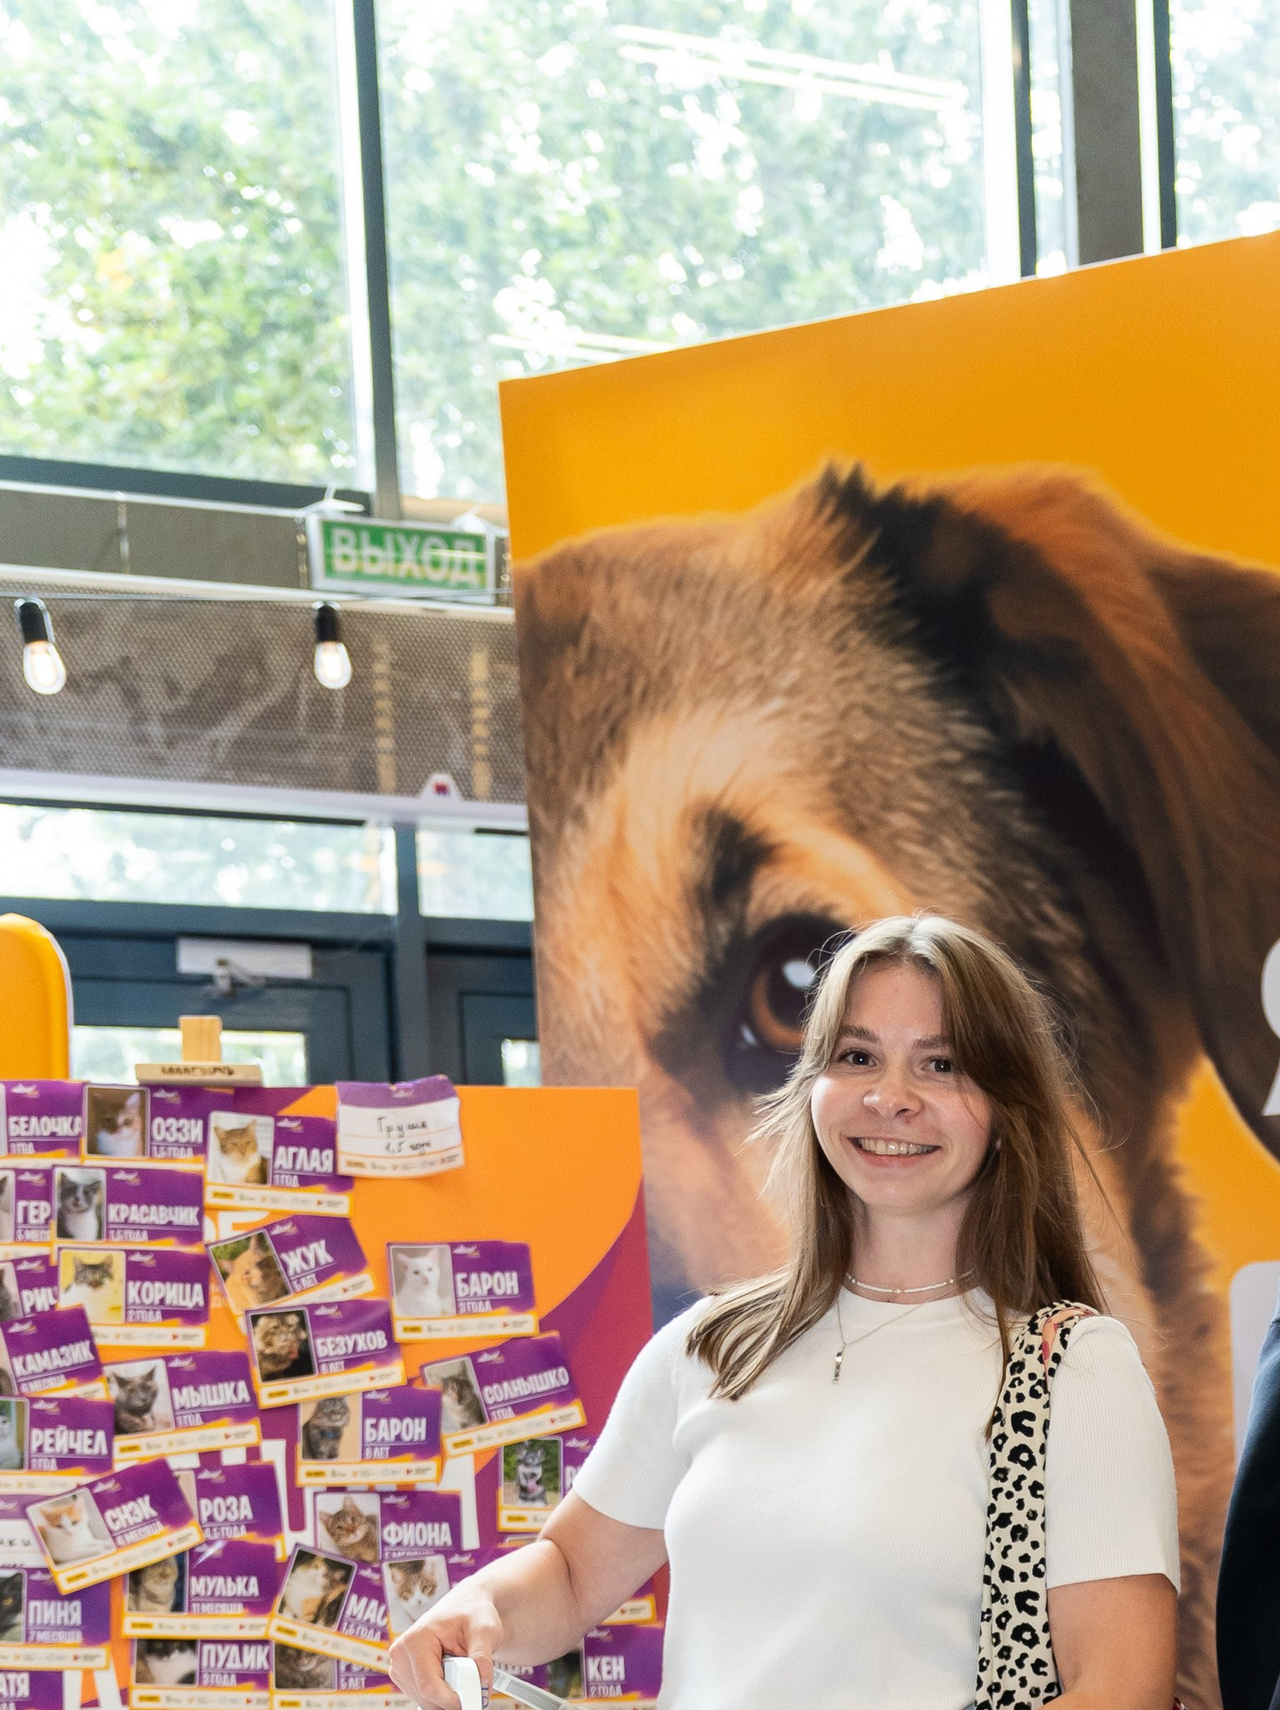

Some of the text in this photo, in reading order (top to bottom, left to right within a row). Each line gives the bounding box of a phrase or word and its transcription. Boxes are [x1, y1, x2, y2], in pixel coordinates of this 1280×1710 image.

[331, 526, 482, 588] ВЫХОД
[9, 1115, 82, 1138] БЕЛОЧКА
[152, 1117, 203, 1144] ОЗЗИ
[274, 1145, 334, 1173] АГЛАЯ
[108, 1203, 200, 1227] КРАСАВЧИК
[280, 1240, 334, 1276] ЖУК
[128, 1281, 204, 1309] КОРИЦА
[455, 1271, 519, 1298] БАРОН
[315, 1330, 387, 1358] БЕЗУХОВ
[12, 1341, 96, 1377] КАМАЗИК
[172, 1380, 251, 1410] МЫШКА
[484, 1367, 570, 1404] СОЛНЫШКО
[31, 1425, 108, 1456] РЕЙЧЕЛ
[364, 1417, 427, 1442] БАРОН
[104, 1495, 158, 1532] СНЭК
[200, 1495, 253, 1523] РОЗА
[383, 1522, 453, 1548] ФИОНА
[190, 1575, 260, 1599] МУЛЬКА
[27, 1600, 82, 1627] ПИНЯ
[202, 1644, 269, 1670] ПУДИК
[586, 1655, 625, 1682] КЕН
